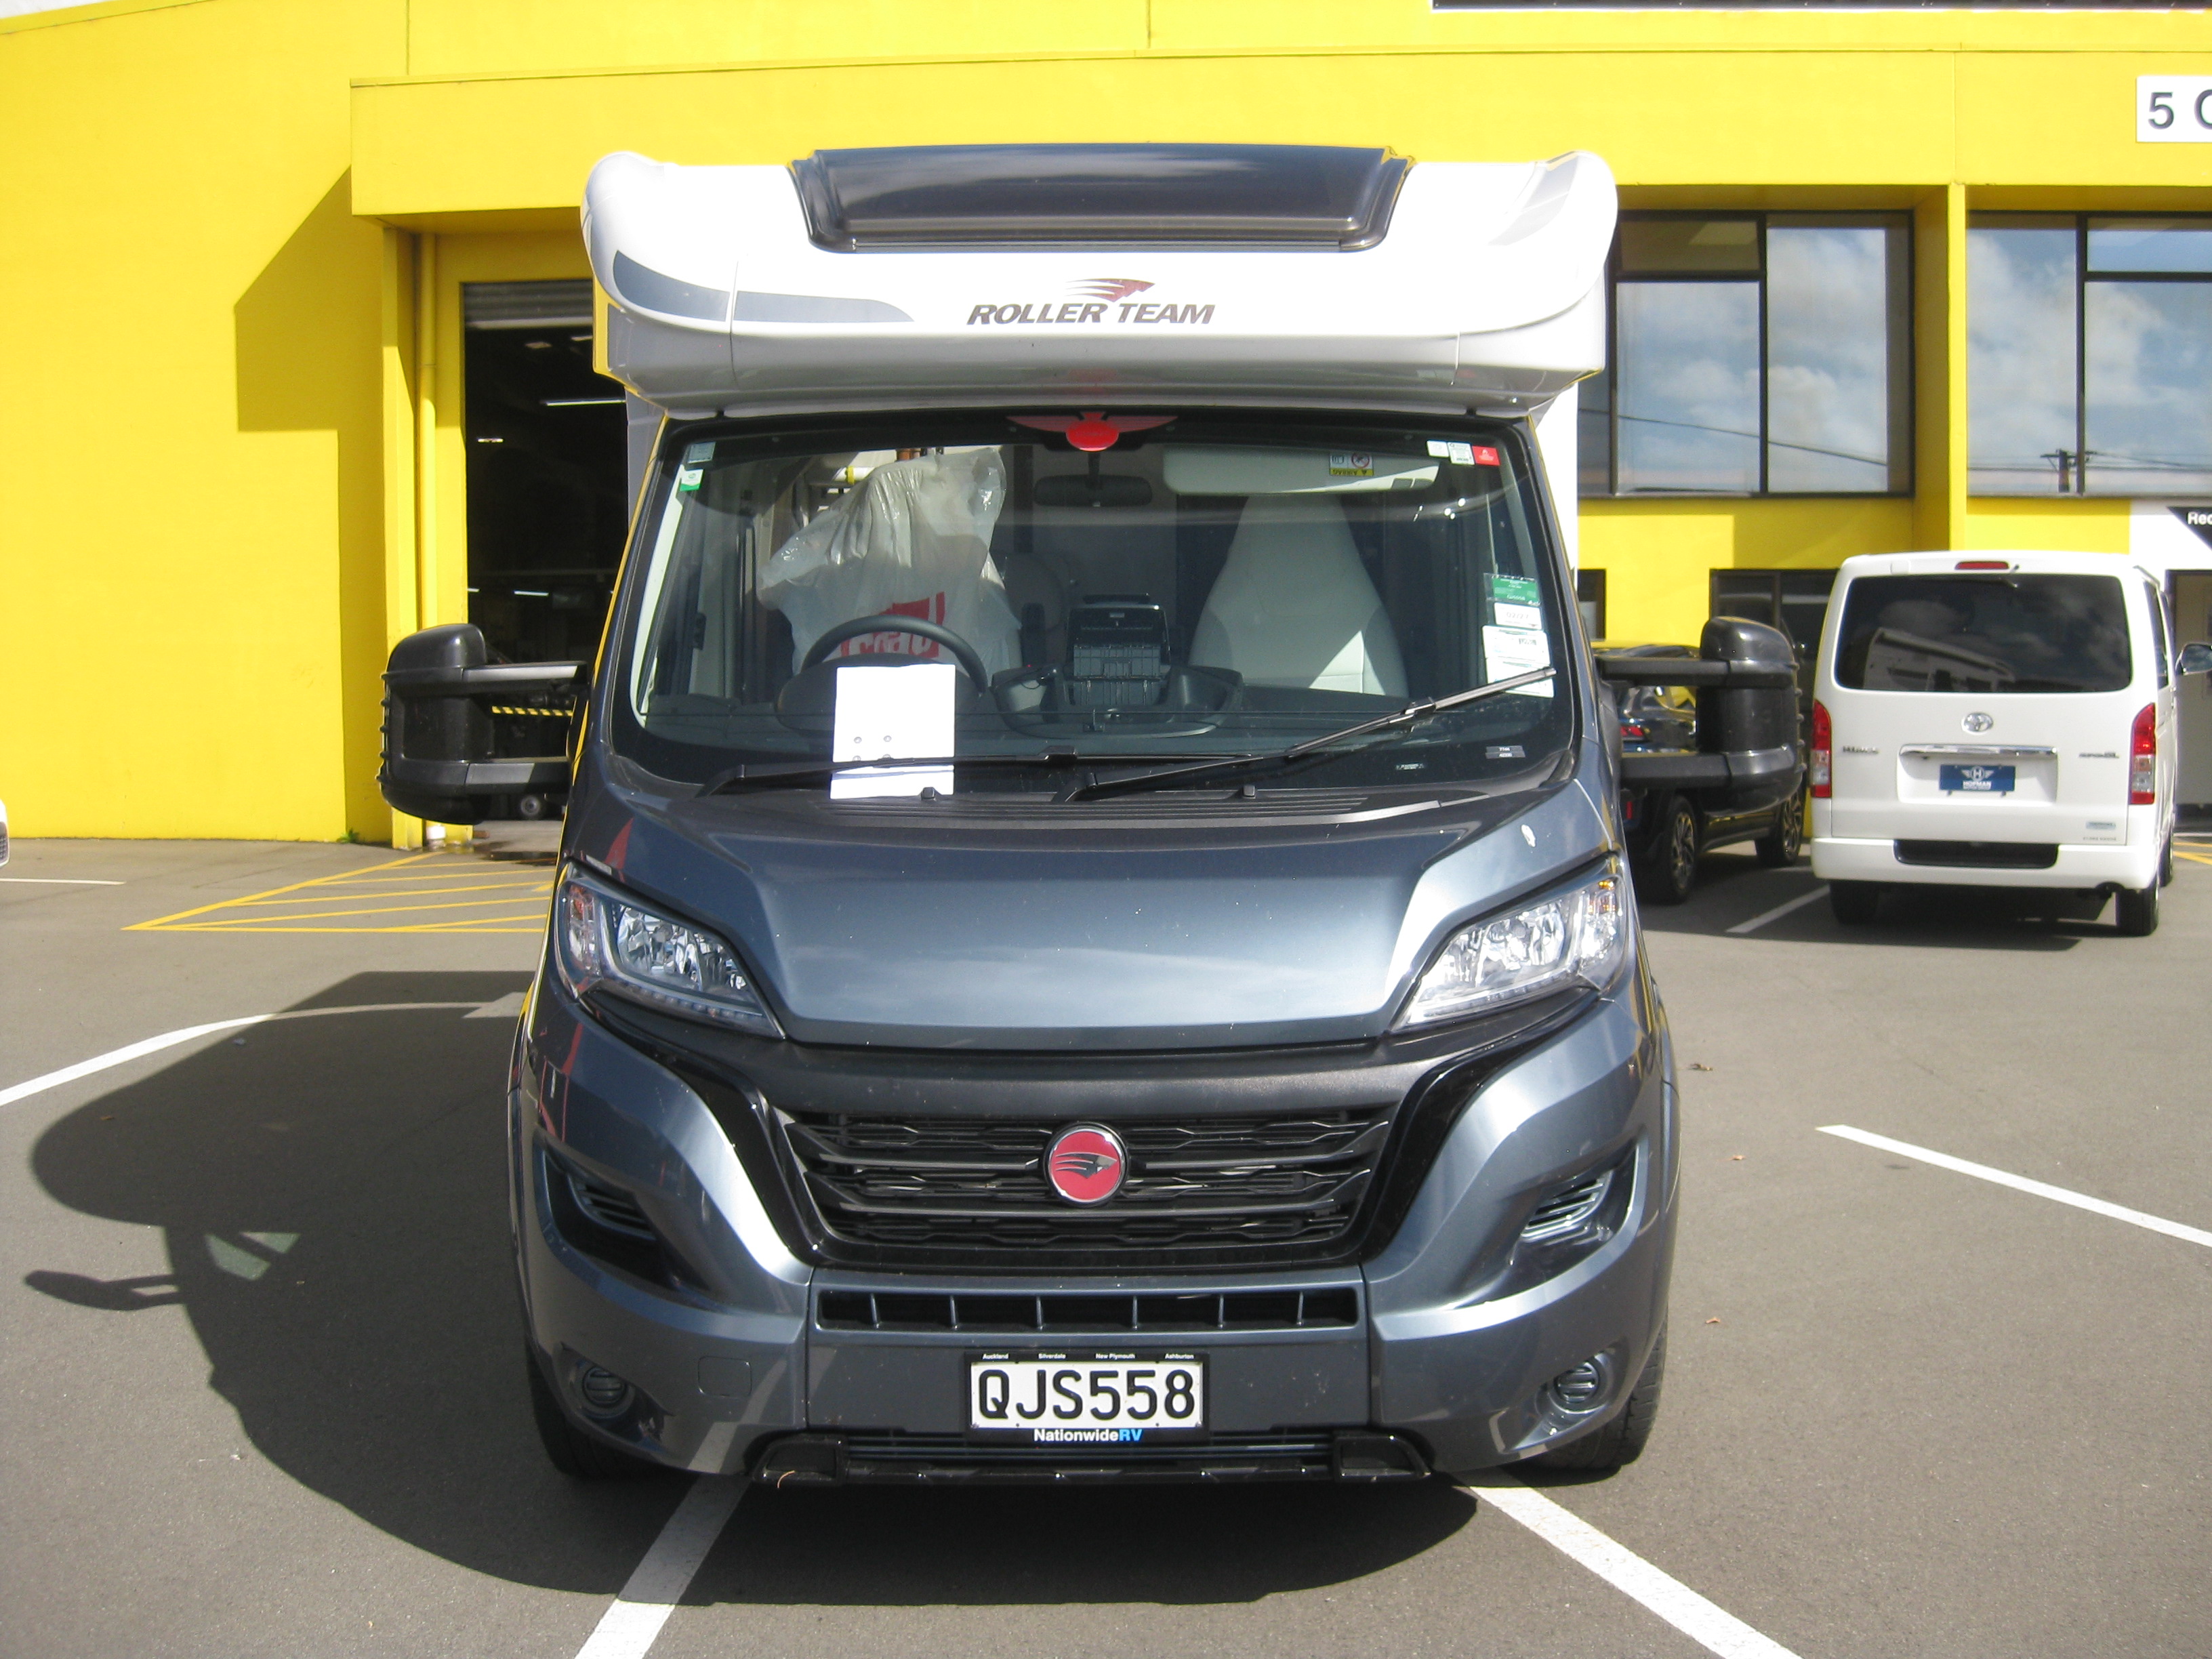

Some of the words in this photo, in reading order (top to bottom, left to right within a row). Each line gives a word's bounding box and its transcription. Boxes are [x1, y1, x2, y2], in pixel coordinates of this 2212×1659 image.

[2148, 91, 2175, 129] 5
[967, 303, 1108, 325] ROLLER
[1118, 304, 1215, 325] TEAM
[979, 1369, 1195, 1420] QJS558
[1033, 1429, 1142, 1442] NationwideRV
